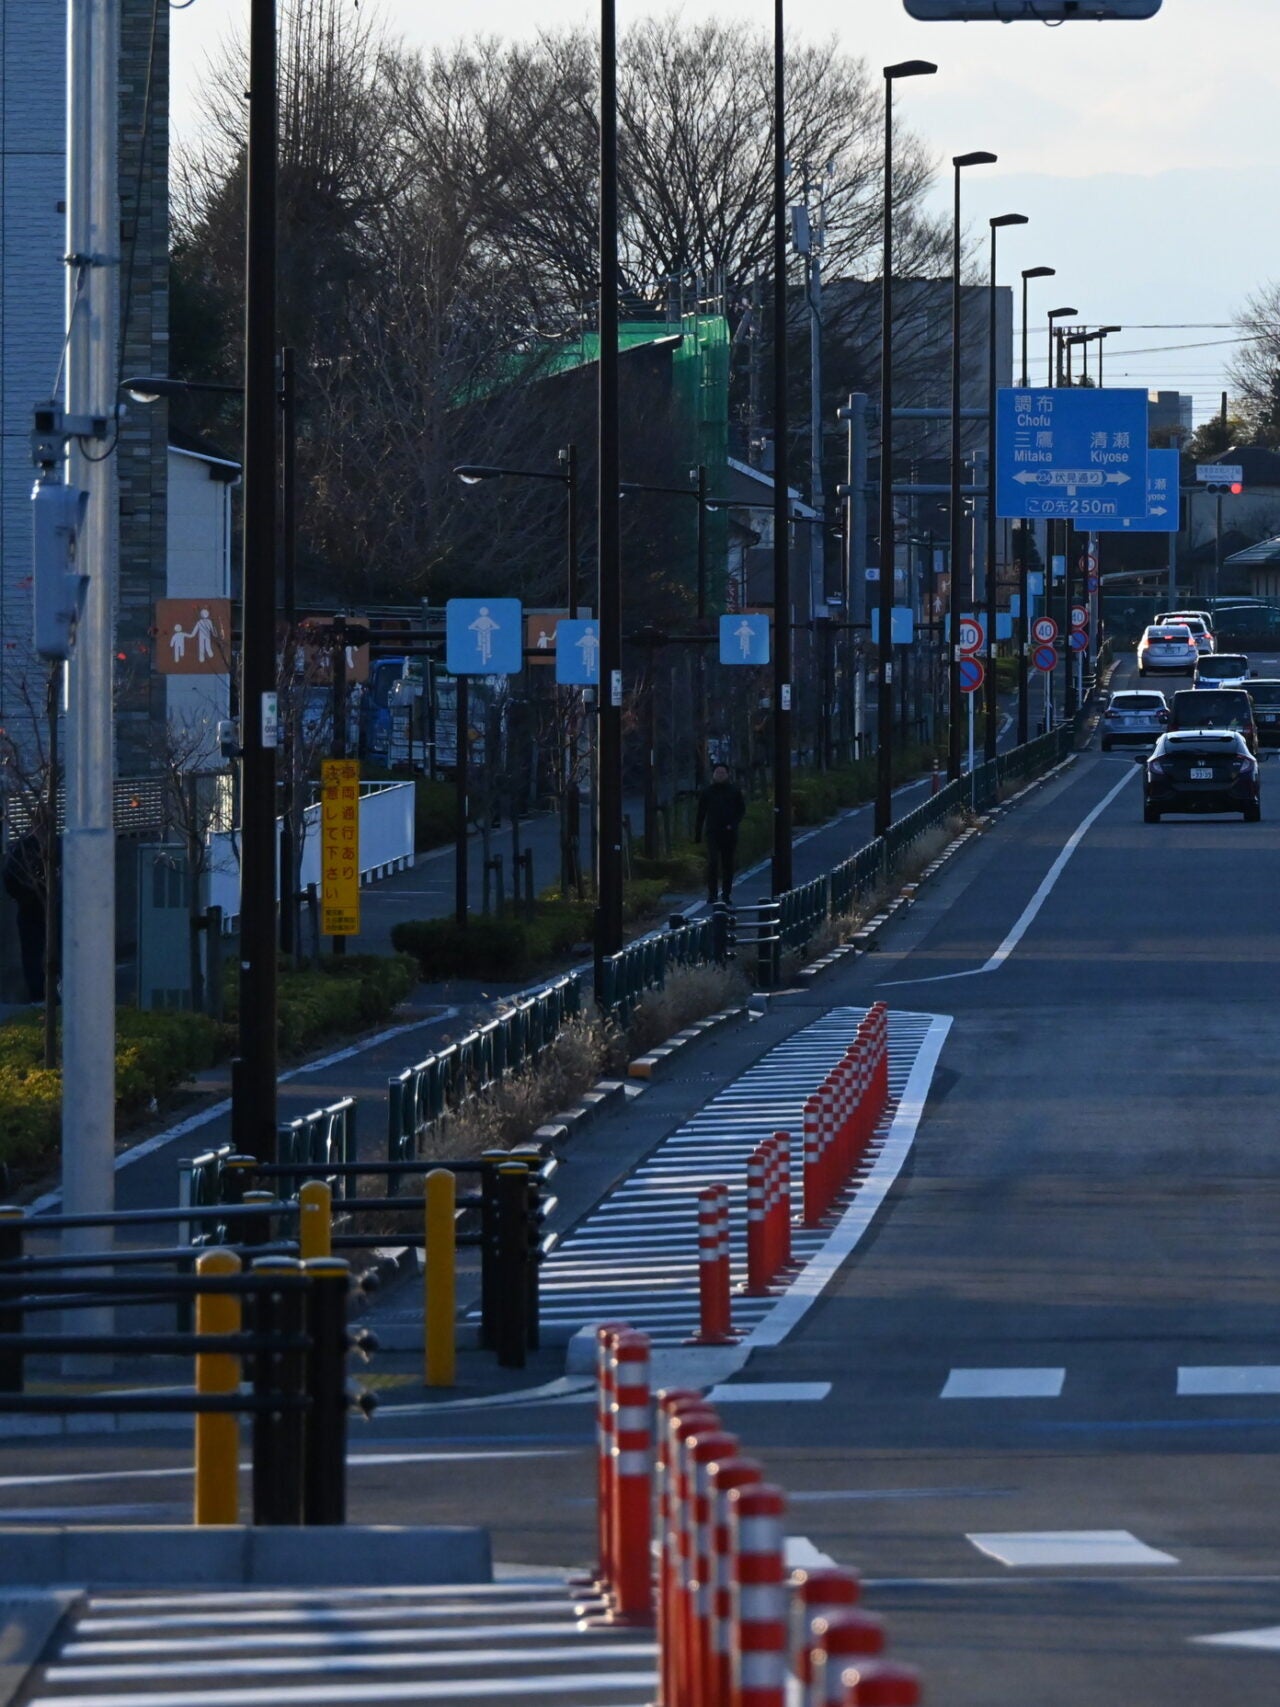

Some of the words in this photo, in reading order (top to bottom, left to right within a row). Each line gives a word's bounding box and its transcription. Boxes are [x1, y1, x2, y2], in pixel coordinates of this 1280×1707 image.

[1014, 395, 1054, 413] 調布
[1017, 414, 1051, 427] Chofu
[1014, 431, 1053, 449] 三鷹
[1090, 431, 1130, 449] 清瀬
[1014, 450, 1053, 462] Mitaka
[1090, 450, 1129, 464] Kiyose
[1055, 472, 1100, 484] 伏見通り
[1038, 624, 1052, 637] 40
[341, 764, 356, 881] 車両通行あり
[325, 765, 340, 900] 注意して下さい
